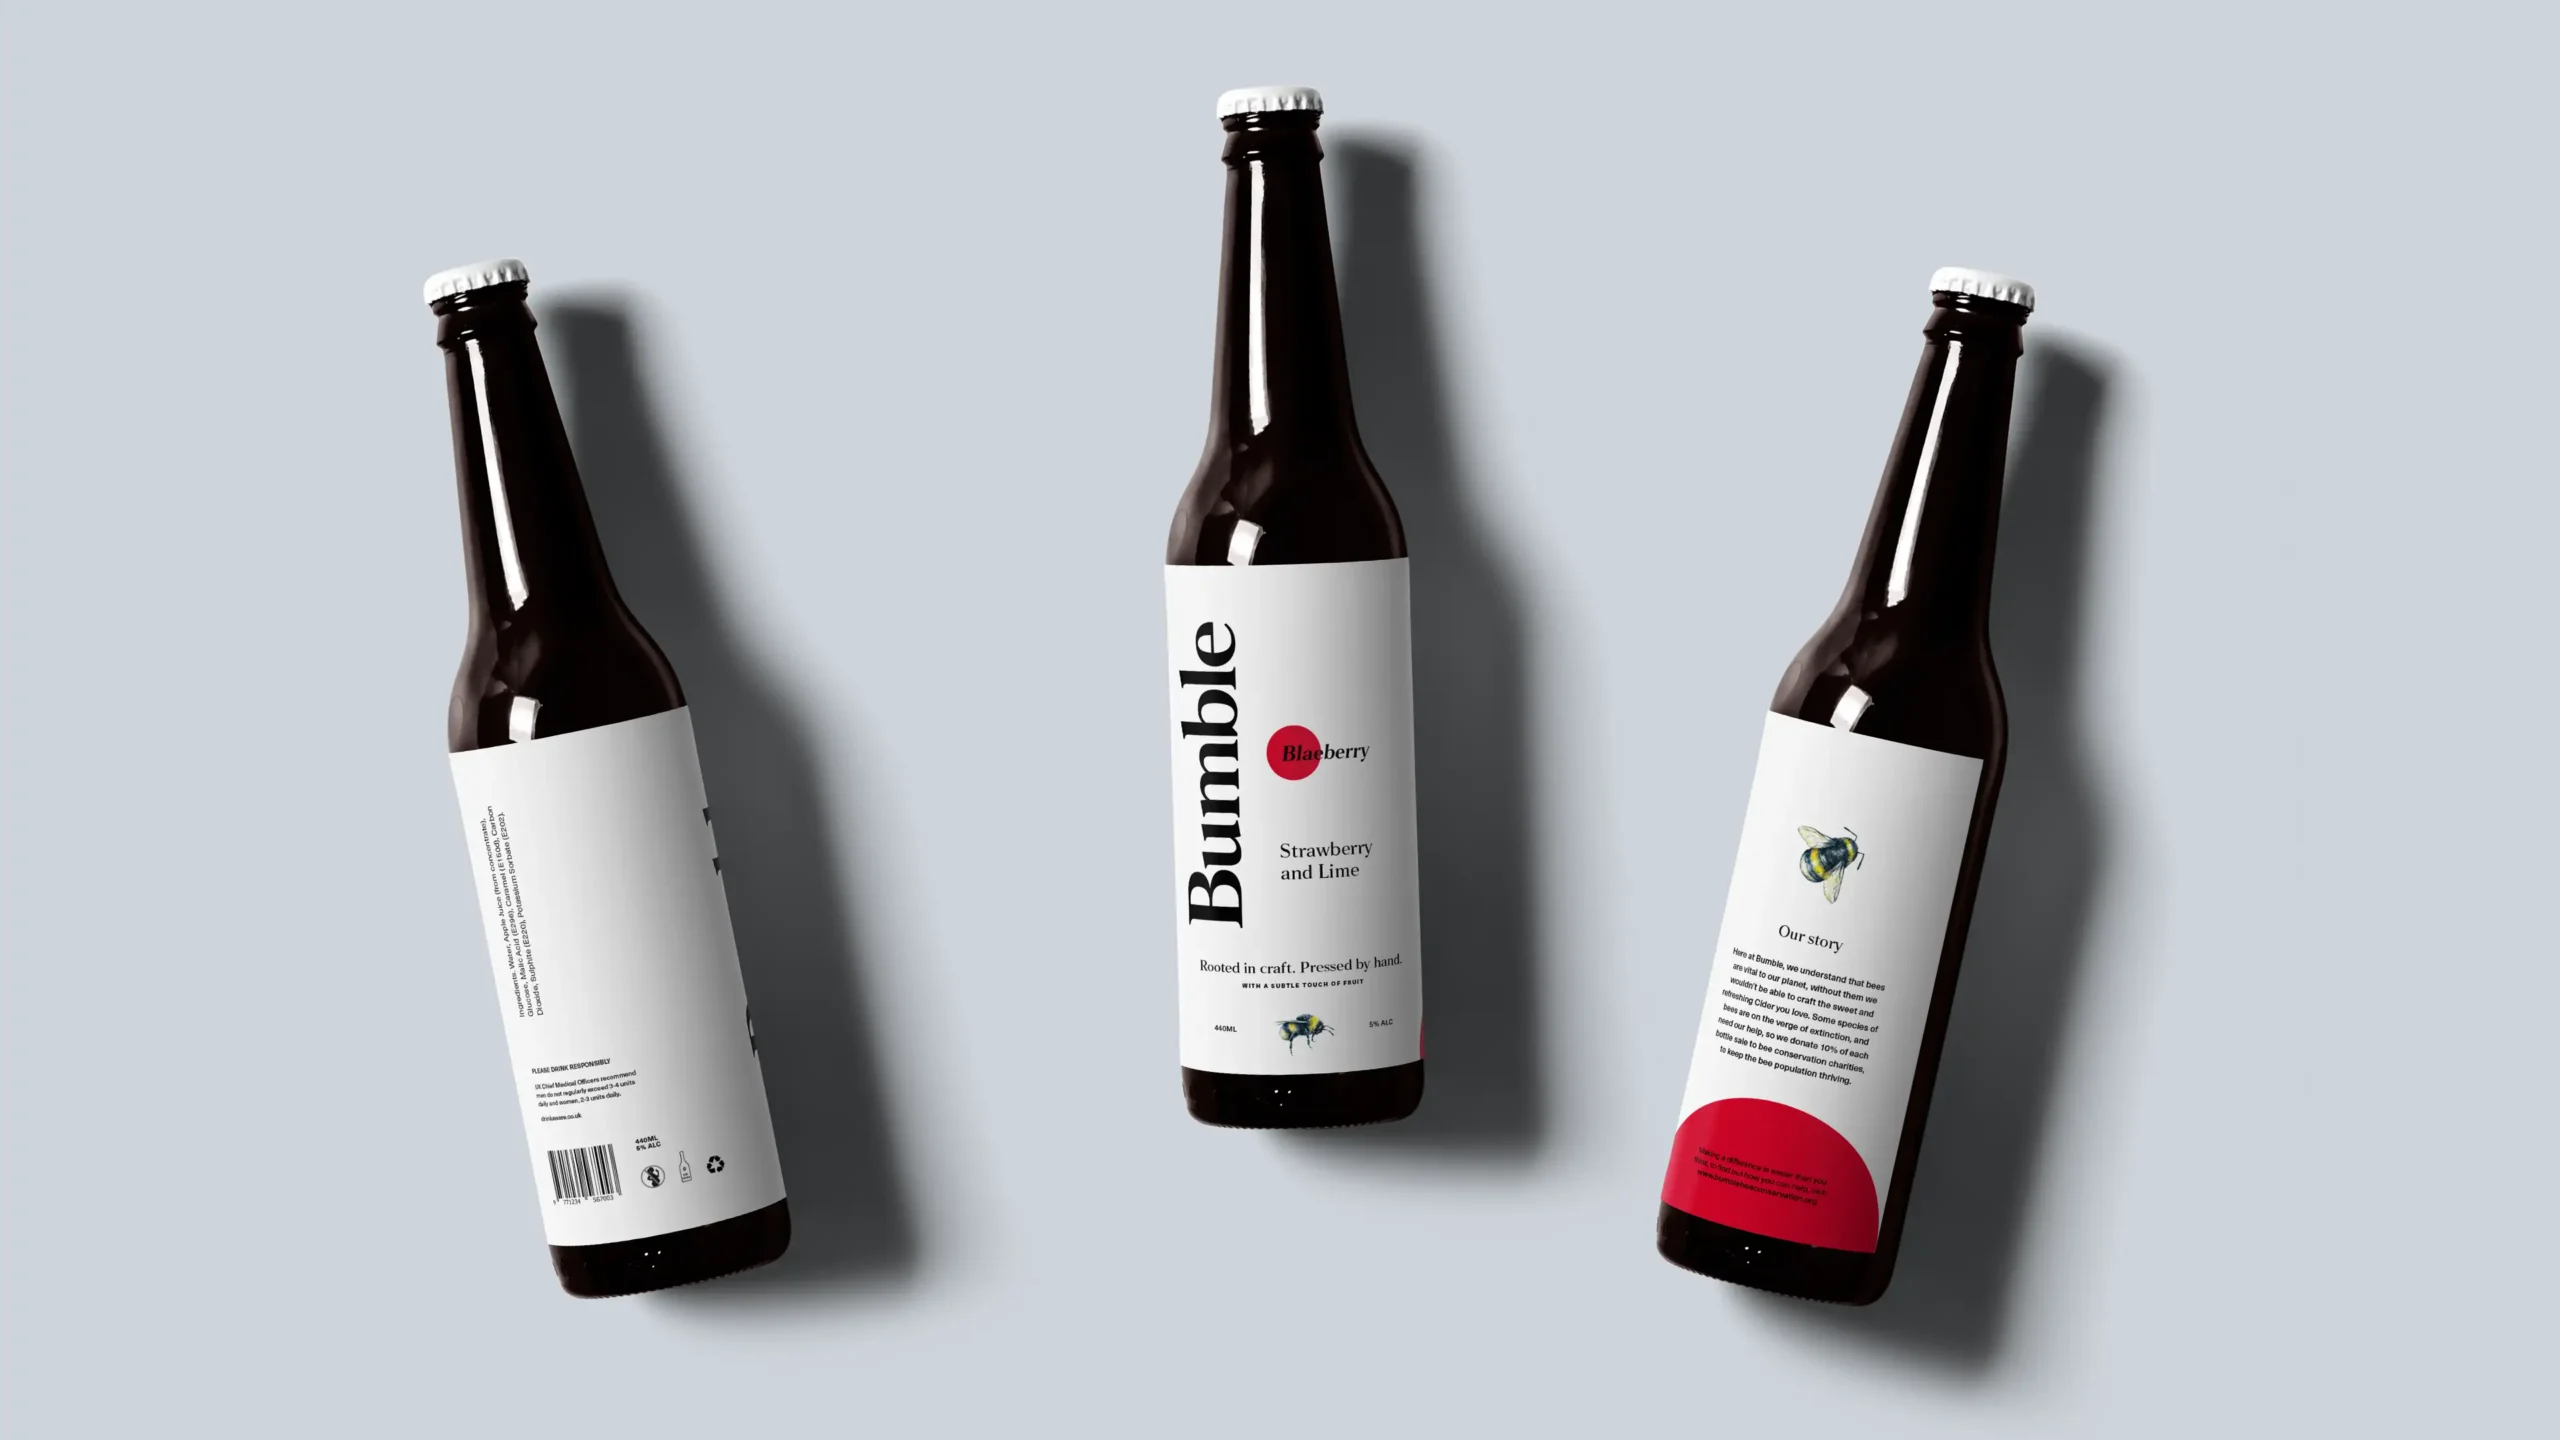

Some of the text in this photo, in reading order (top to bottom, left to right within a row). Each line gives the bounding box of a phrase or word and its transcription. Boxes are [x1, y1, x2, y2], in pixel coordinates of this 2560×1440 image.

[1283, 743, 1370, 762] Blaeberry
[1179, 622, 1243, 929] Bumble
[487, 806, 498, 836] Carbon
[1280, 841, 1372, 858] Strawberry
[1281, 863, 1360, 880] and Lime
[500, 872, 512, 907] Caramel
[480, 818, 525, 1018] Ingredients. Water, Apple Juice (from concentrate),
[497, 812, 544, 1016] Dioxide, Sulphite (E220), Potassium Sorbate (E202).
[507, 908, 519, 937] (E296),
[513, 938, 522, 957] Acid
[1778, 925, 1843, 954] Our story
[518, 958, 527, 980] Malic
[1200, 953, 1402, 974] Rooted in craft. Pressed by hand.
[1733, 947, 1885, 991] Here at Bumble, we understand that bees
[1732, 963, 1878, 1004] are vital to our planet, without them we
[523, 981, 534, 1017] Glucose,
[1722, 989, 1879, 1033] refreshing Cider you love. Some species of
[1758, 984, 1768, 994] be
[1769, 988, 1786, 998] able
[1787, 992, 1796, 1001] to
[1796, 996, 1816, 1006] craft
[1817, 1000, 1831, 1009] the
[1832, 1004, 1858, 1015] sweet
[1858, 1009, 1875, 1018] and
[1214, 1025, 1237, 1033] 440ML
[1380, 1018, 1393, 1026] ALC
[1723, 1003, 1870, 1046] bees are on the verge of extinction, and
[1715, 1029, 1865, 1074] bottle sale to bee conservation charities,
[1718, 1017, 1869, 1060] need our help, so we donate 10% of each
[550, 1065, 569, 1073] DRINK
[569, 1058, 610, 1070] RESPONSIBLY
[1720, 1045, 1852, 1085] to keep the bee population thriving.
[541, 1082, 555, 1090] Chief
[555, 1080, 577, 1088] Medical
[600, 1070, 637, 1082] recommend
[563, 1088, 587, 1096] regularly
[587, 1084, 609, 1092] exceed
[605, 1091, 621, 1099] daily.
[635, 1135, 659, 1145] 440ML
[648, 1141, 661, 1149] ALC
